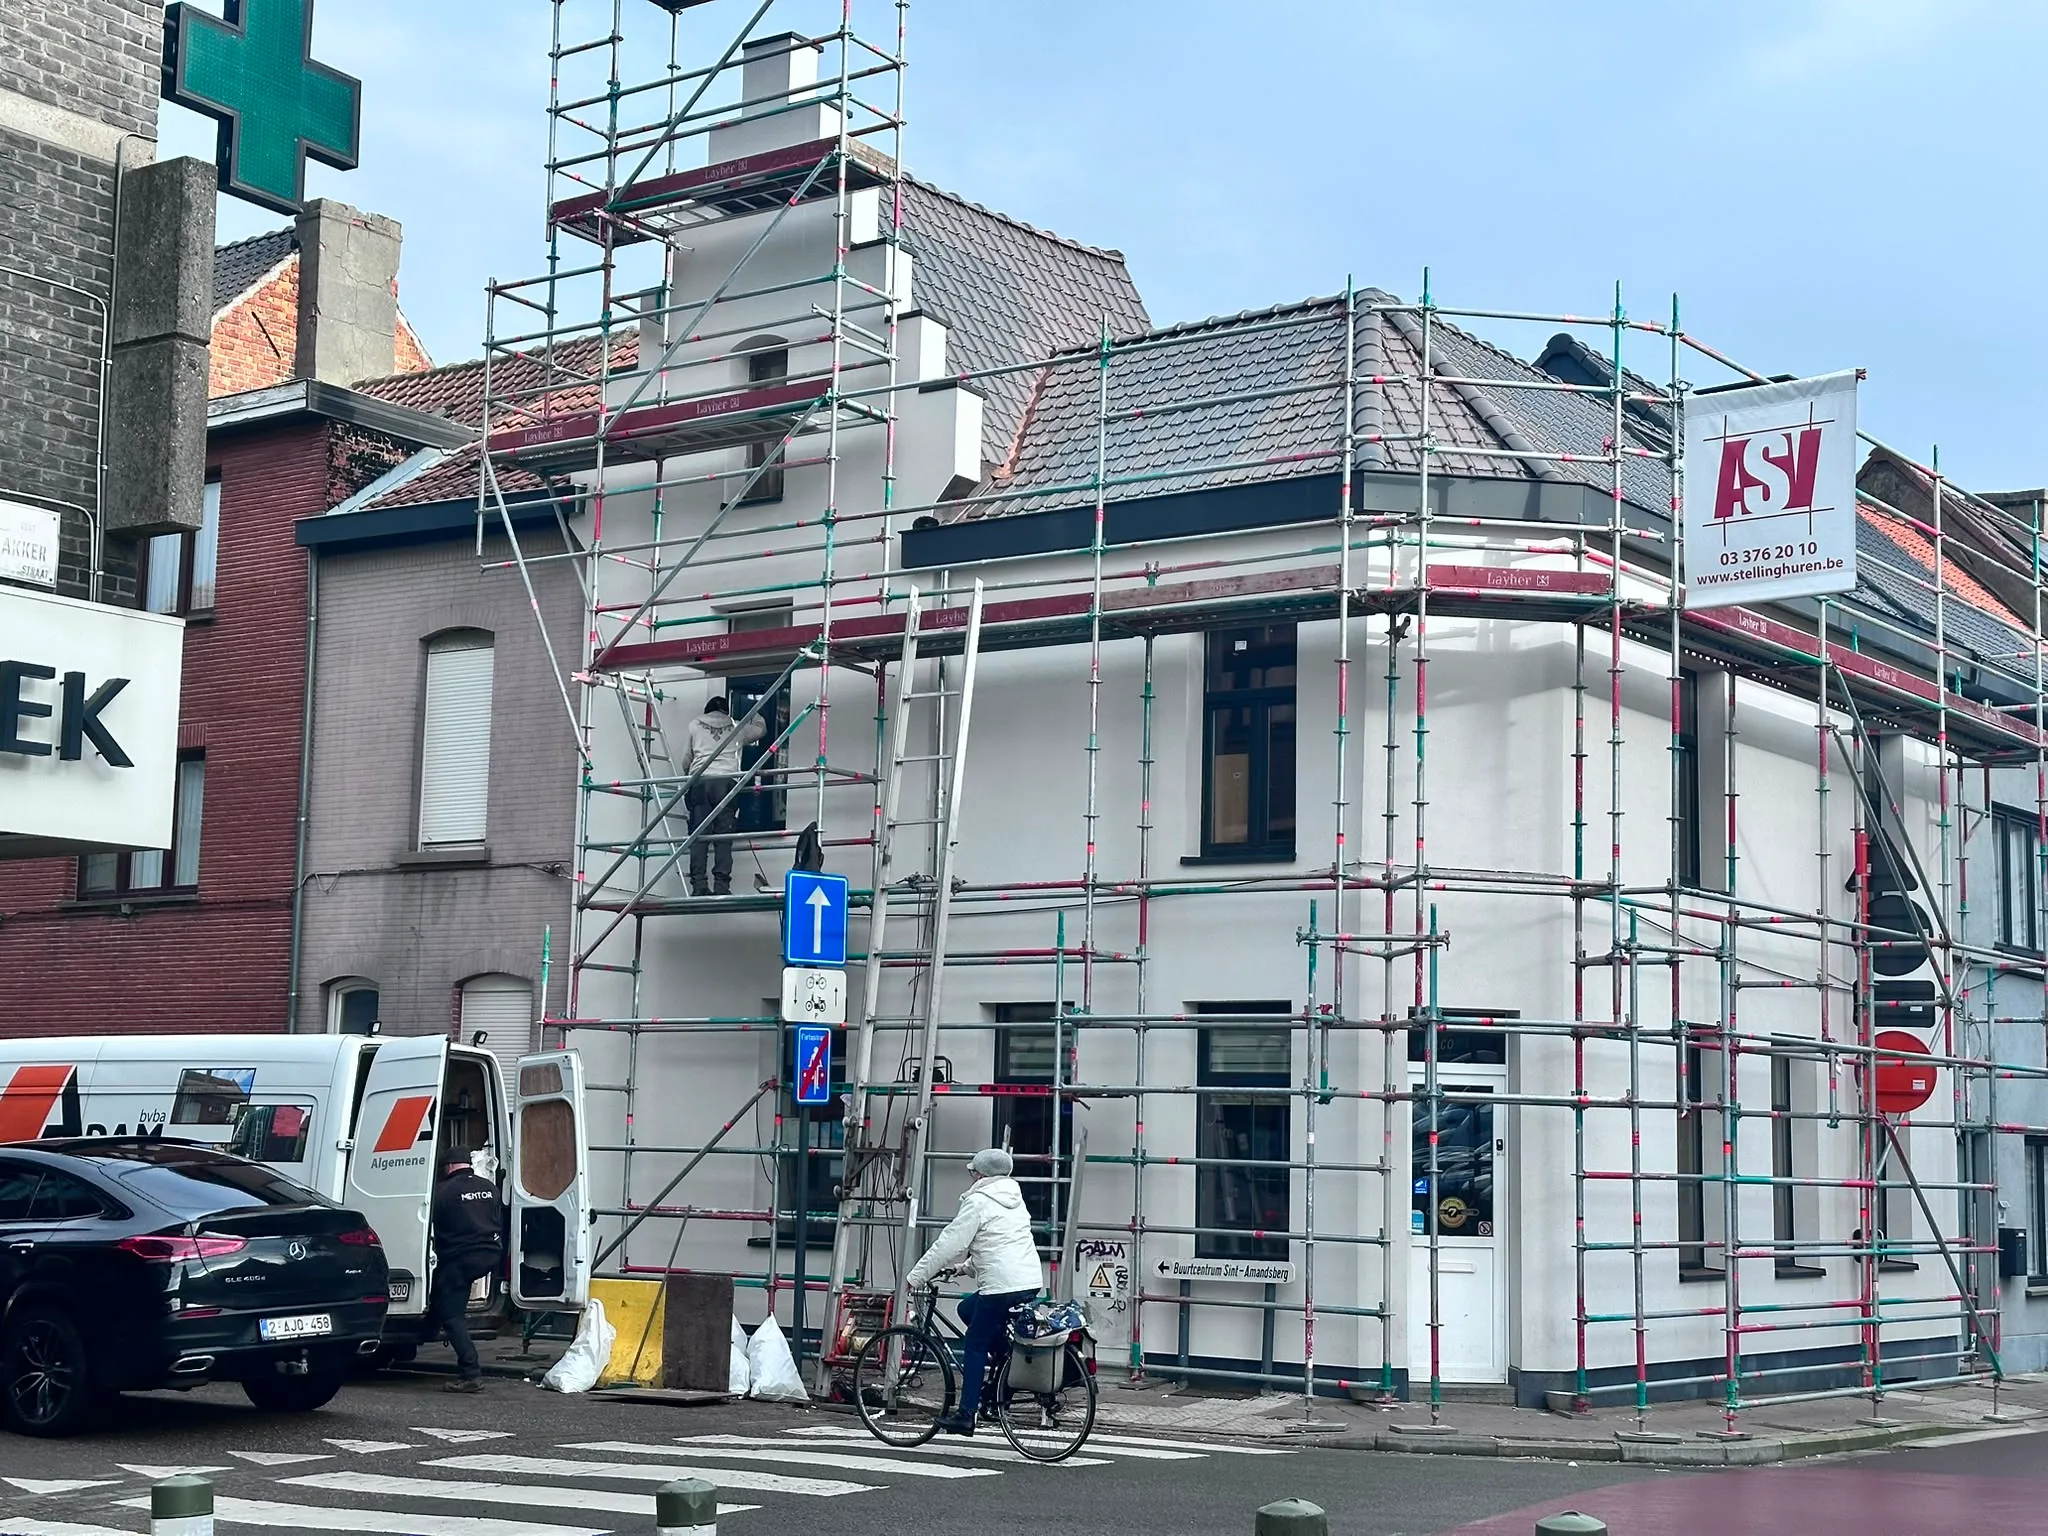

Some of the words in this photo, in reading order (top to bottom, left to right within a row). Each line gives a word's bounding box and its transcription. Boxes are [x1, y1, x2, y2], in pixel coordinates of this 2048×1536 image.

[696, 400, 728, 414] Layher
[1714, 428, 1822, 519] ASV
[1720, 552, 1739, 565] 03
[1742, 547, 1771, 562] 376
[1775, 544, 1794, 558] 20
[1798, 541, 1818, 556] 10
[1697, 557, 1844, 585] www.stellinghuren.be
[1487, 572, 1532, 587] Layher
[936, 610, 967, 625] Layhe
[686, 640, 717, 654] Layher
[0, 660, 135, 768] EK
[139, 1108, 166, 1122] bvba
[371, 1156, 426, 1171] Algemene
[461, 1191, 493, 1201] MENTOR
[1173, 1262, 1222, 1277] Buurtcentrum
[1223, 1264, 1289, 1282] Sint-Amandsberg
